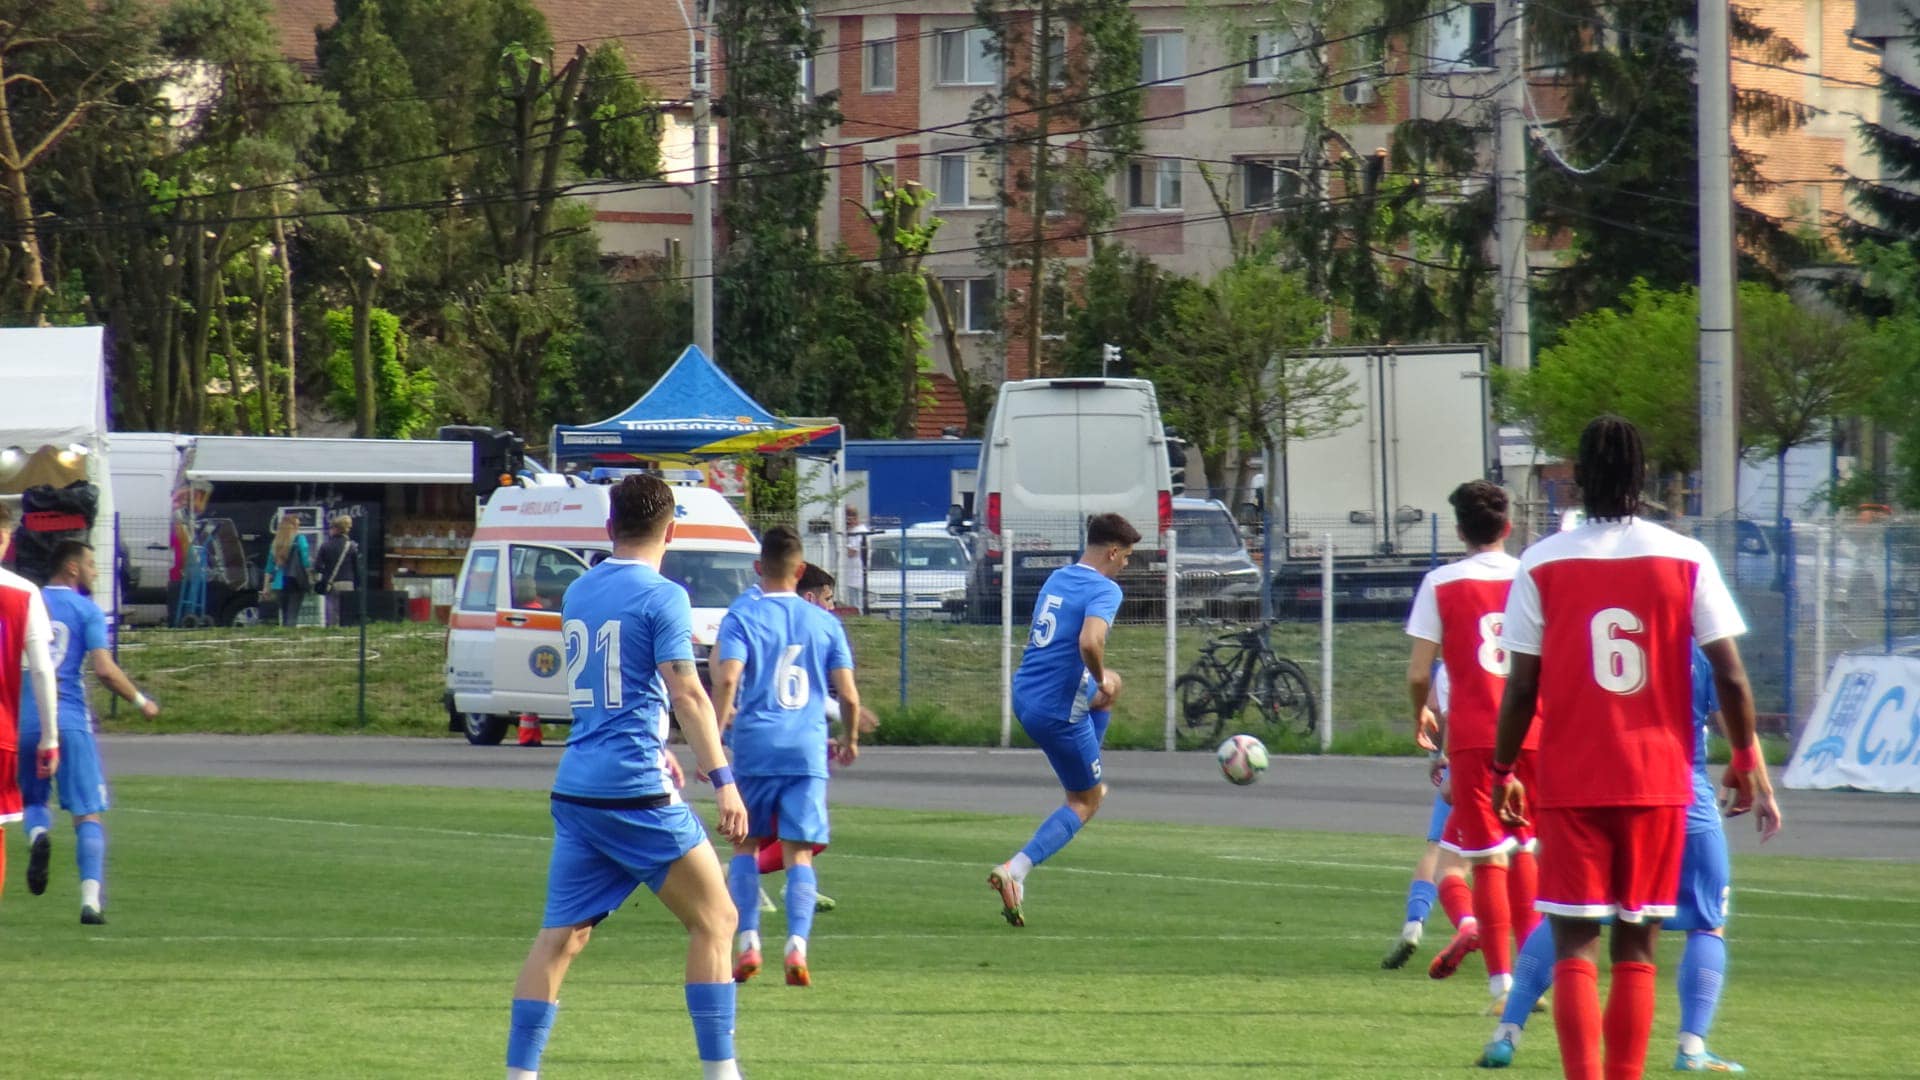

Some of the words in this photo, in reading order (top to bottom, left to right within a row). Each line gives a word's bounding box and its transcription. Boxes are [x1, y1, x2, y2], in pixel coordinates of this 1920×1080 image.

[1032, 594, 1063, 648] 5
[1477, 612, 1510, 678] 8
[1590, 607, 1647, 695] 6
[564, 619, 623, 709] 21
[774, 644, 810, 710] 6
[1091, 758, 1101, 780] 5
